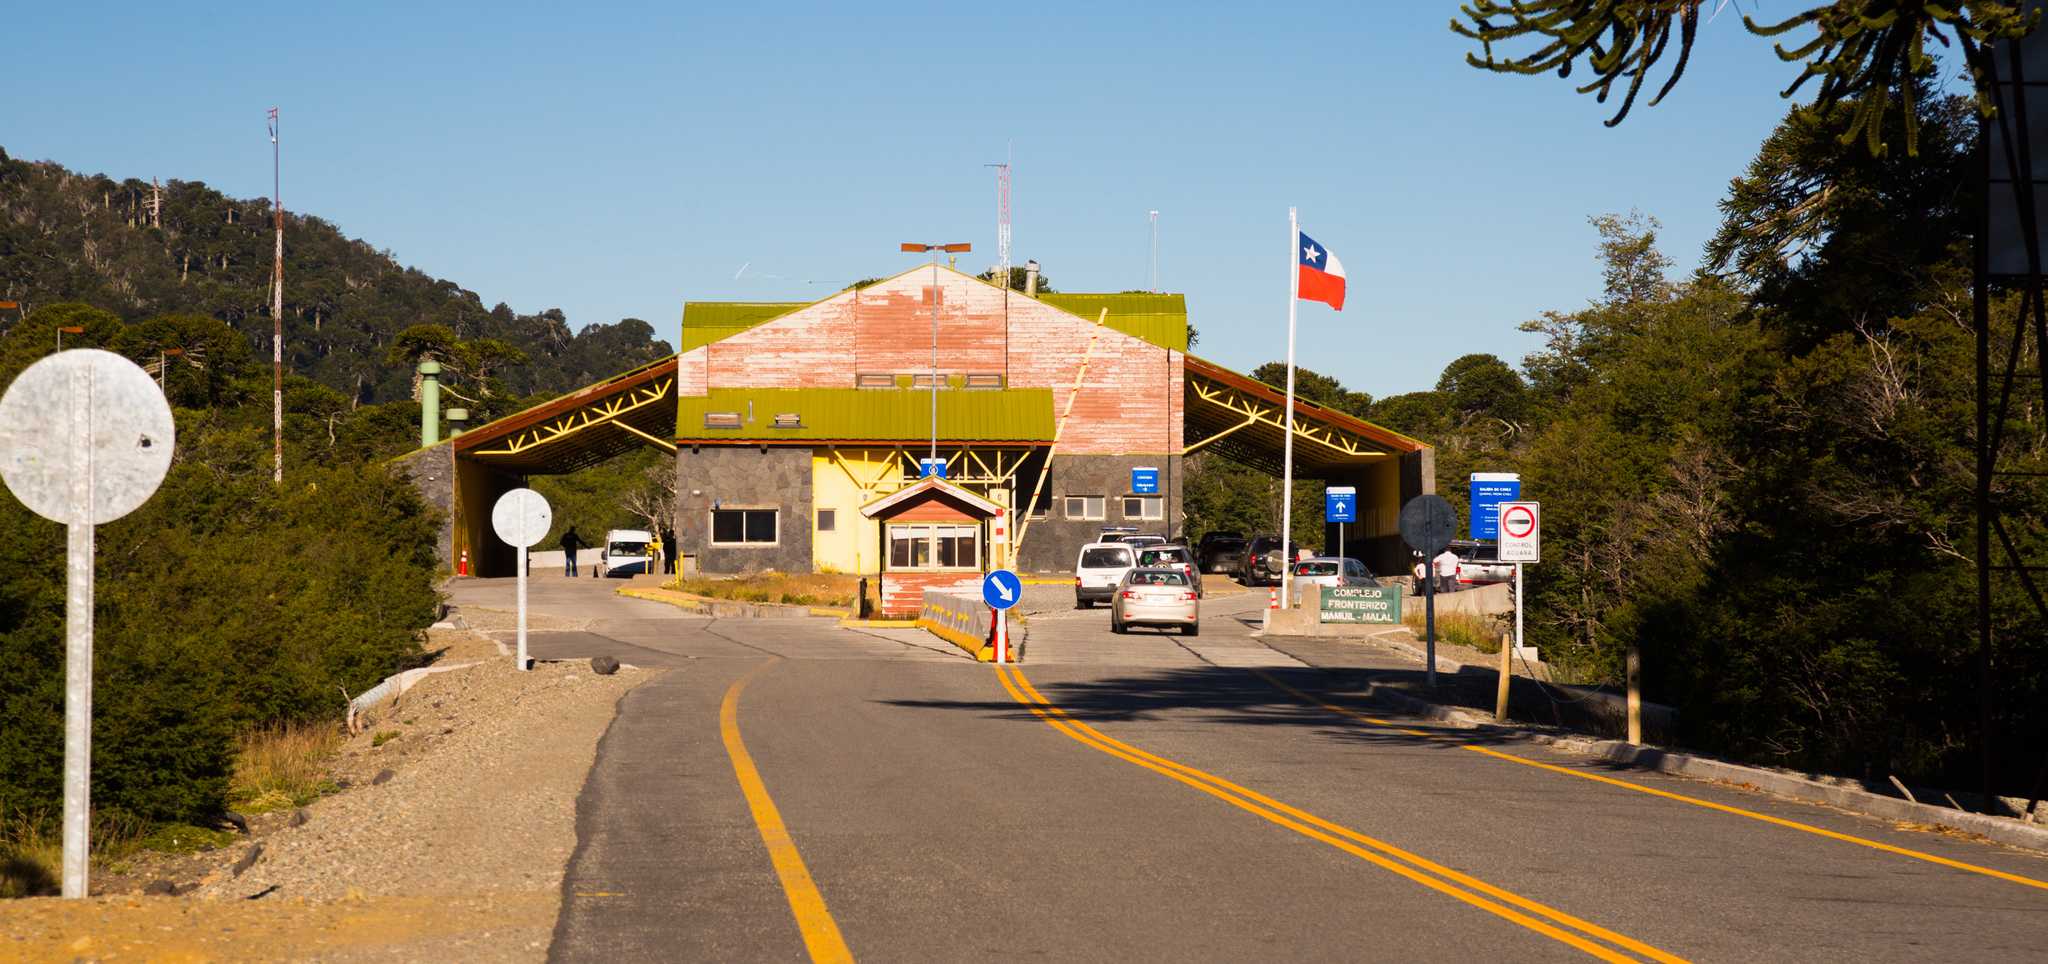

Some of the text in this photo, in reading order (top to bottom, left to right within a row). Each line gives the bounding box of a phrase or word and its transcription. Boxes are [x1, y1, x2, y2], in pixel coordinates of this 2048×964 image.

[1334, 589, 1382, 598] COMPLEJO
[1328, 599, 1388, 610] FRONTERIZO
[1321, 612, 1355, 620] MAMUIL
[1362, 612, 1393, 621] MALAL
